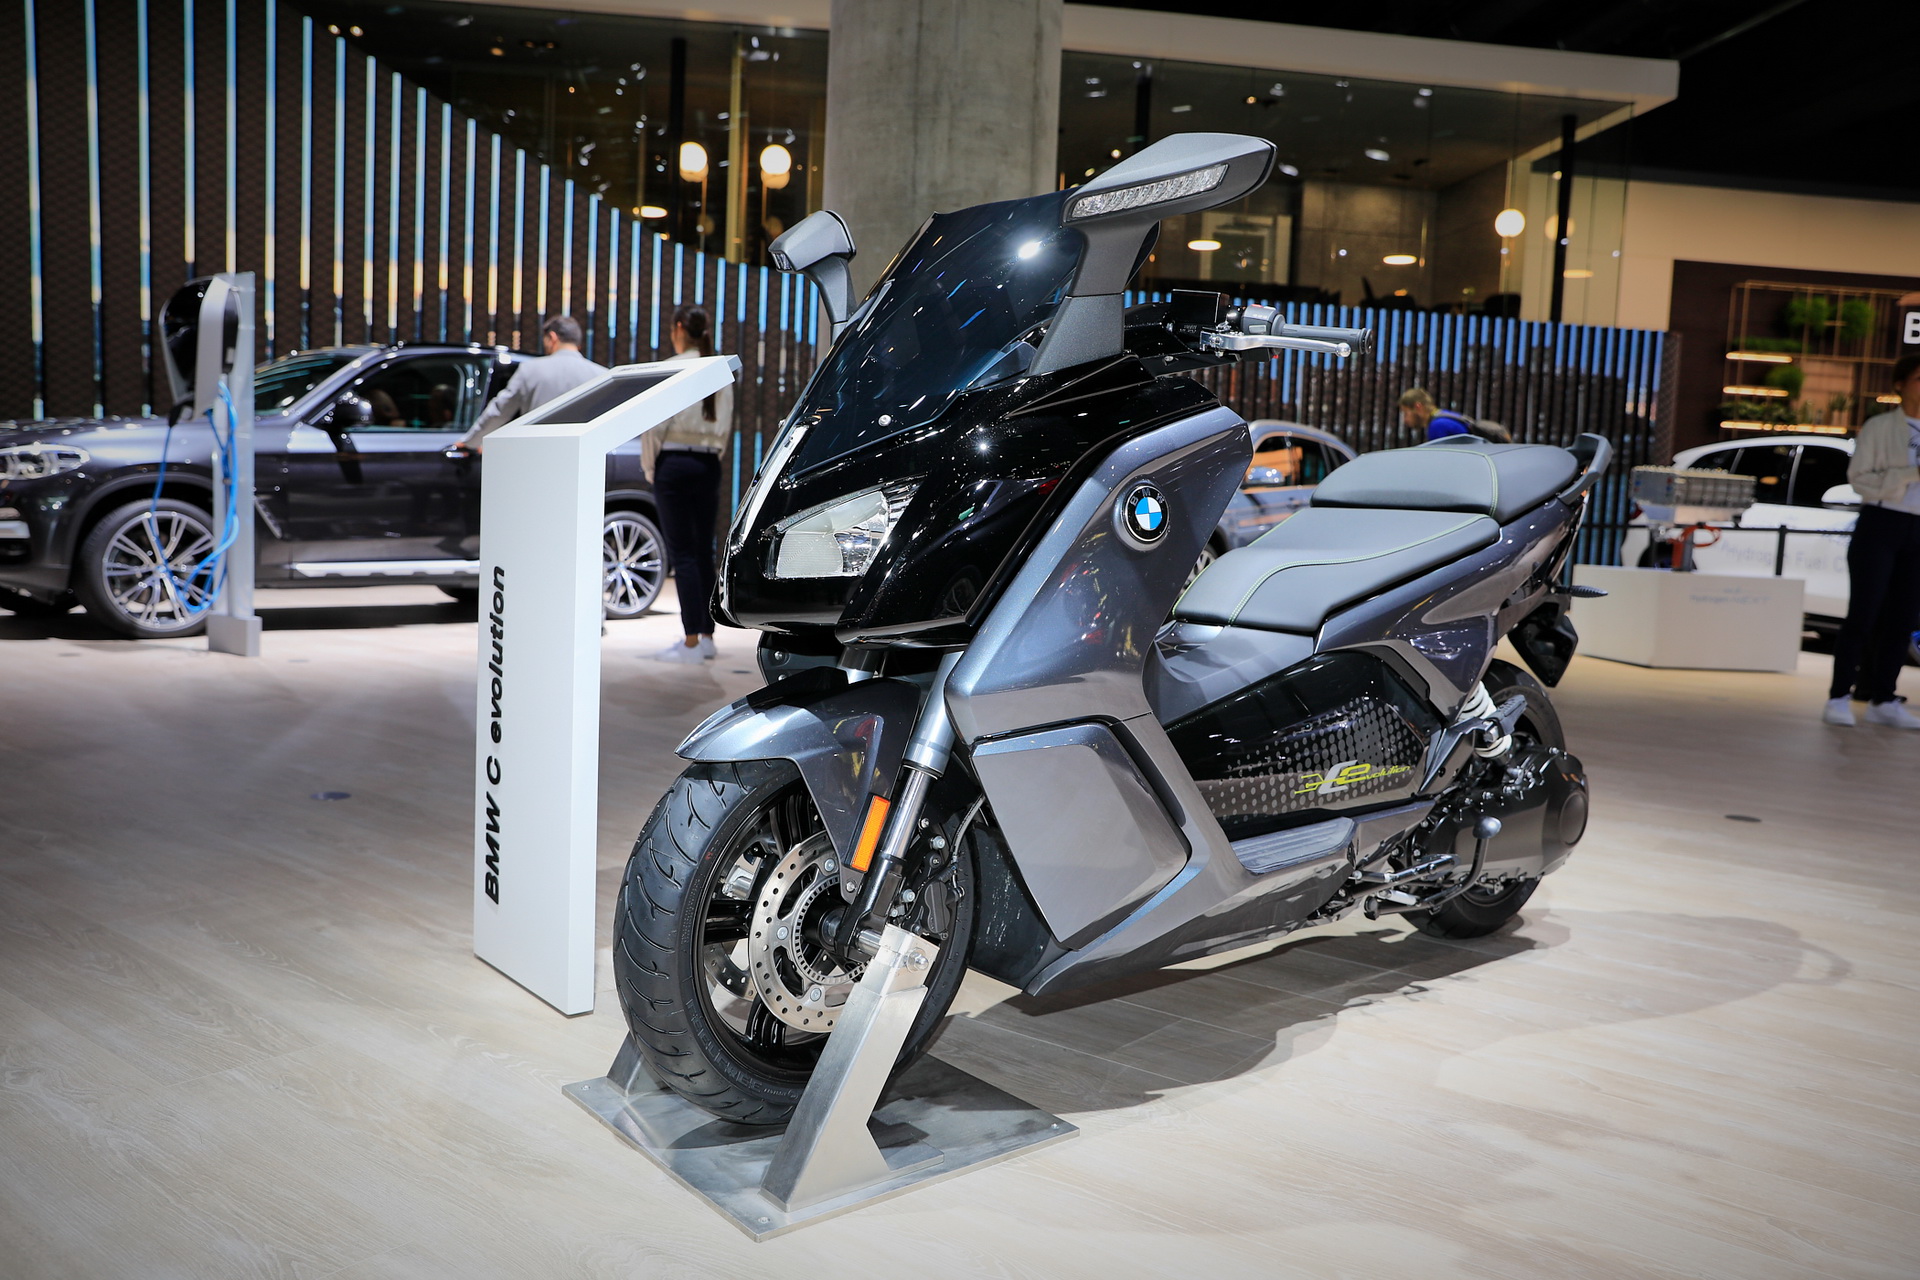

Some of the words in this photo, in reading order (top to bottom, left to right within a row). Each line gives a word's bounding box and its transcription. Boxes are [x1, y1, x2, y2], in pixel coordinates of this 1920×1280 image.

[489, 566, 505, 743] evolution
[486, 755, 501, 785] C
[485, 791, 500, 905] BMW
